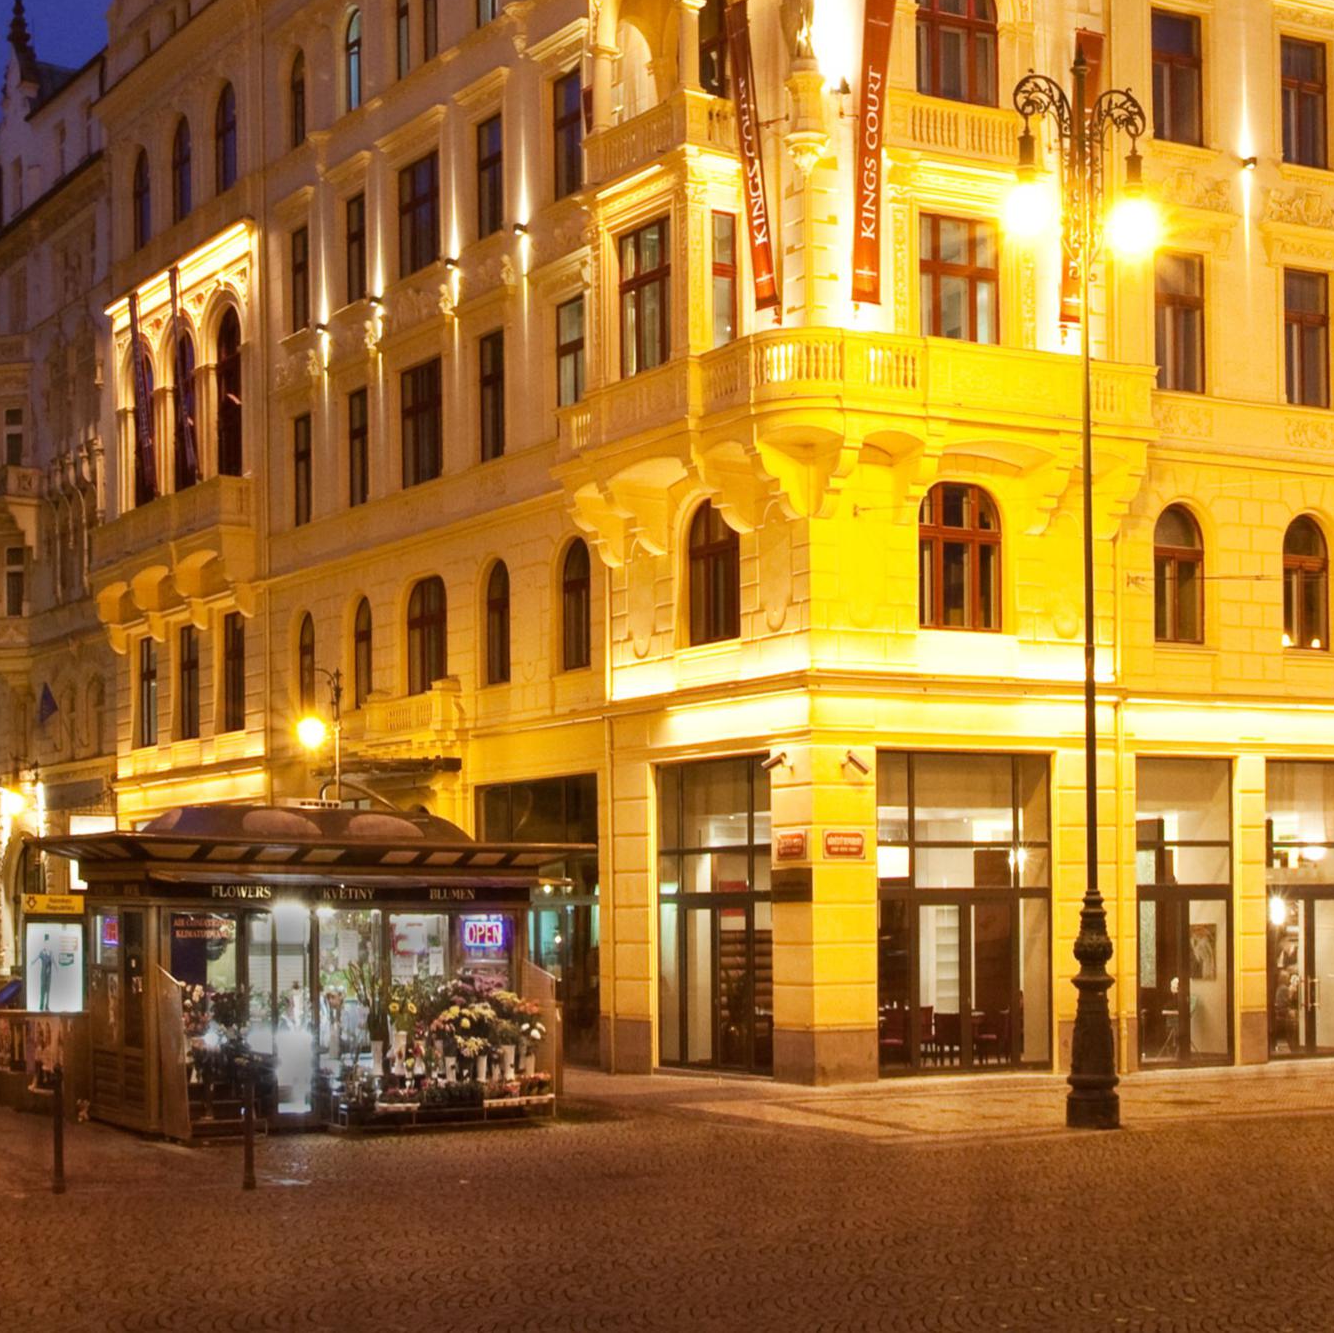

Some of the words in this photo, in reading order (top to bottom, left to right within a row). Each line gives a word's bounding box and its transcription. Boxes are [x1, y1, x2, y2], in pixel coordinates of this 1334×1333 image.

[865, 65, 882, 150] COURT
[748, 158, 769, 246] KINGS
[861, 157, 877, 240] KINGS
[211, 885, 272, 899] FLOWERS
[429, 888, 476, 900] BLUMEN
[466, 923, 501, 944] OPEN
